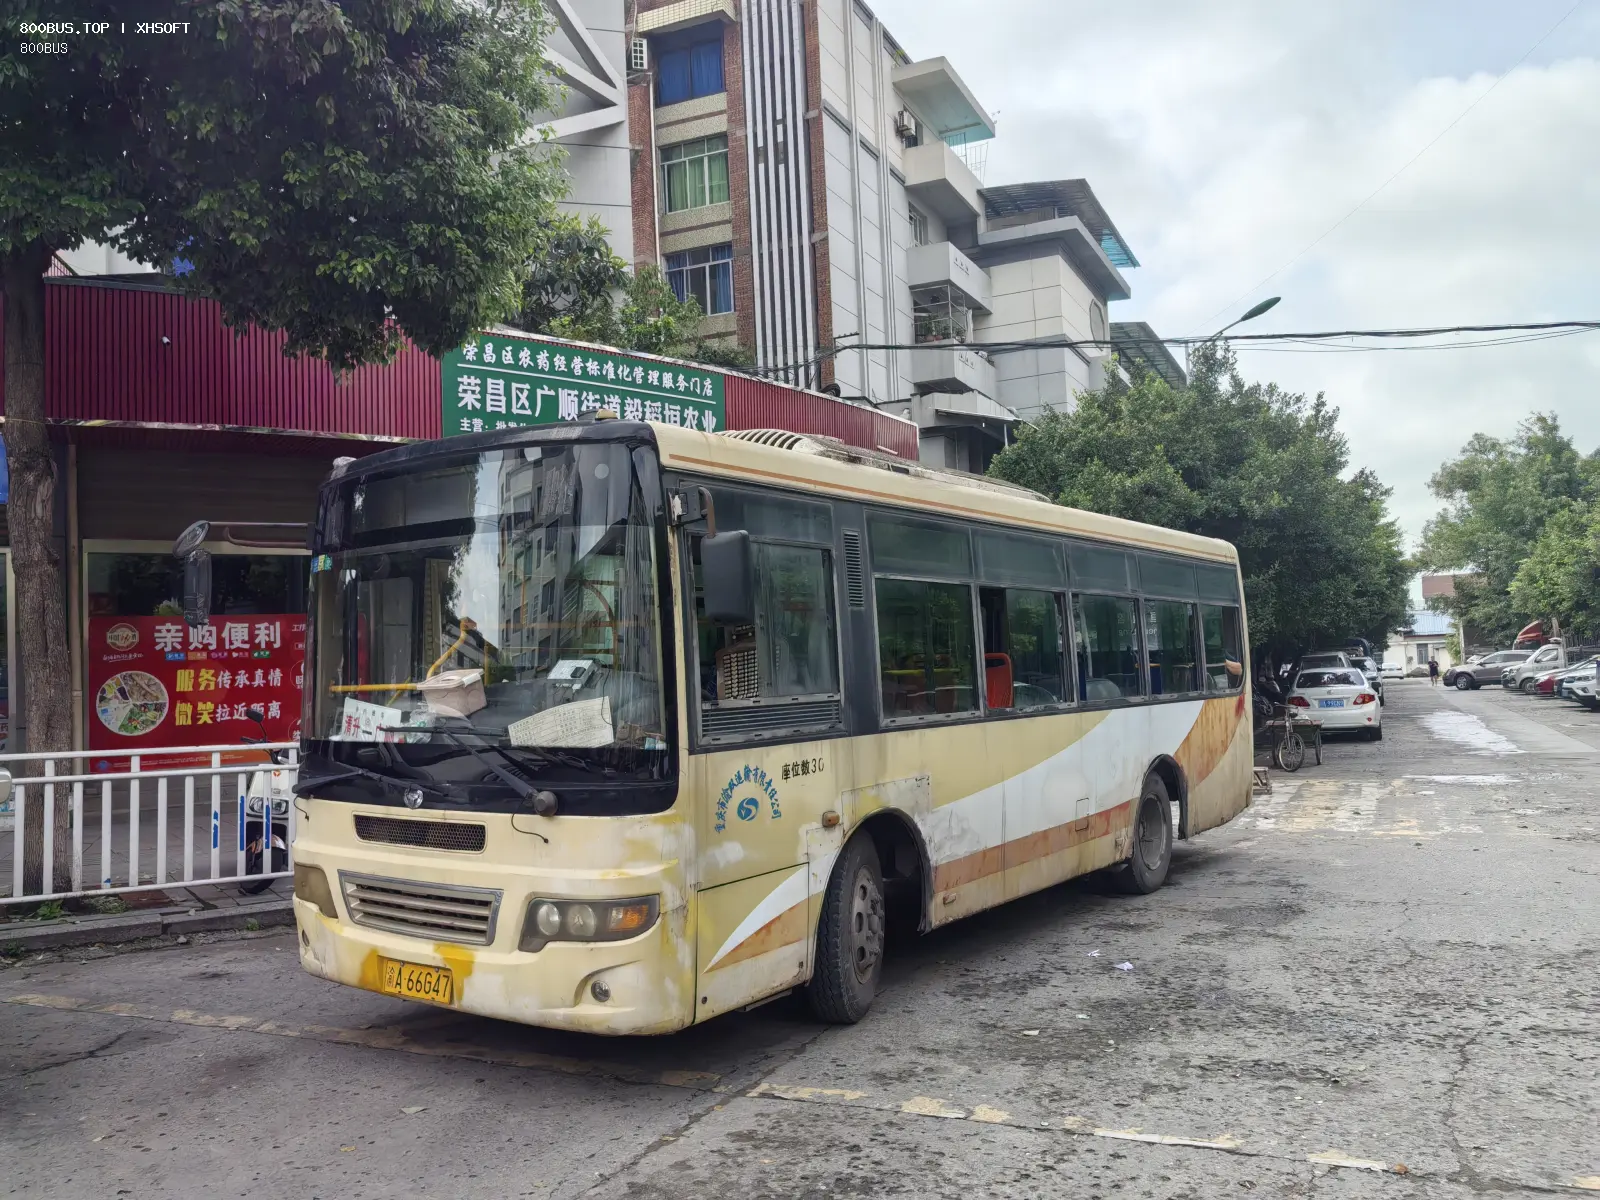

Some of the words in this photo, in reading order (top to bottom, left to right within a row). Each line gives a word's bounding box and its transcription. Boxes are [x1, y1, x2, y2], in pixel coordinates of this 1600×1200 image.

[462, 342, 713, 397] 荣昌区农药经营标准化管理服务门店
[153, 621, 281, 652] 亲购便利
[175, 667, 283, 692] 服务传承真情
[174, 700, 282, 726] 微笑拉近距离
